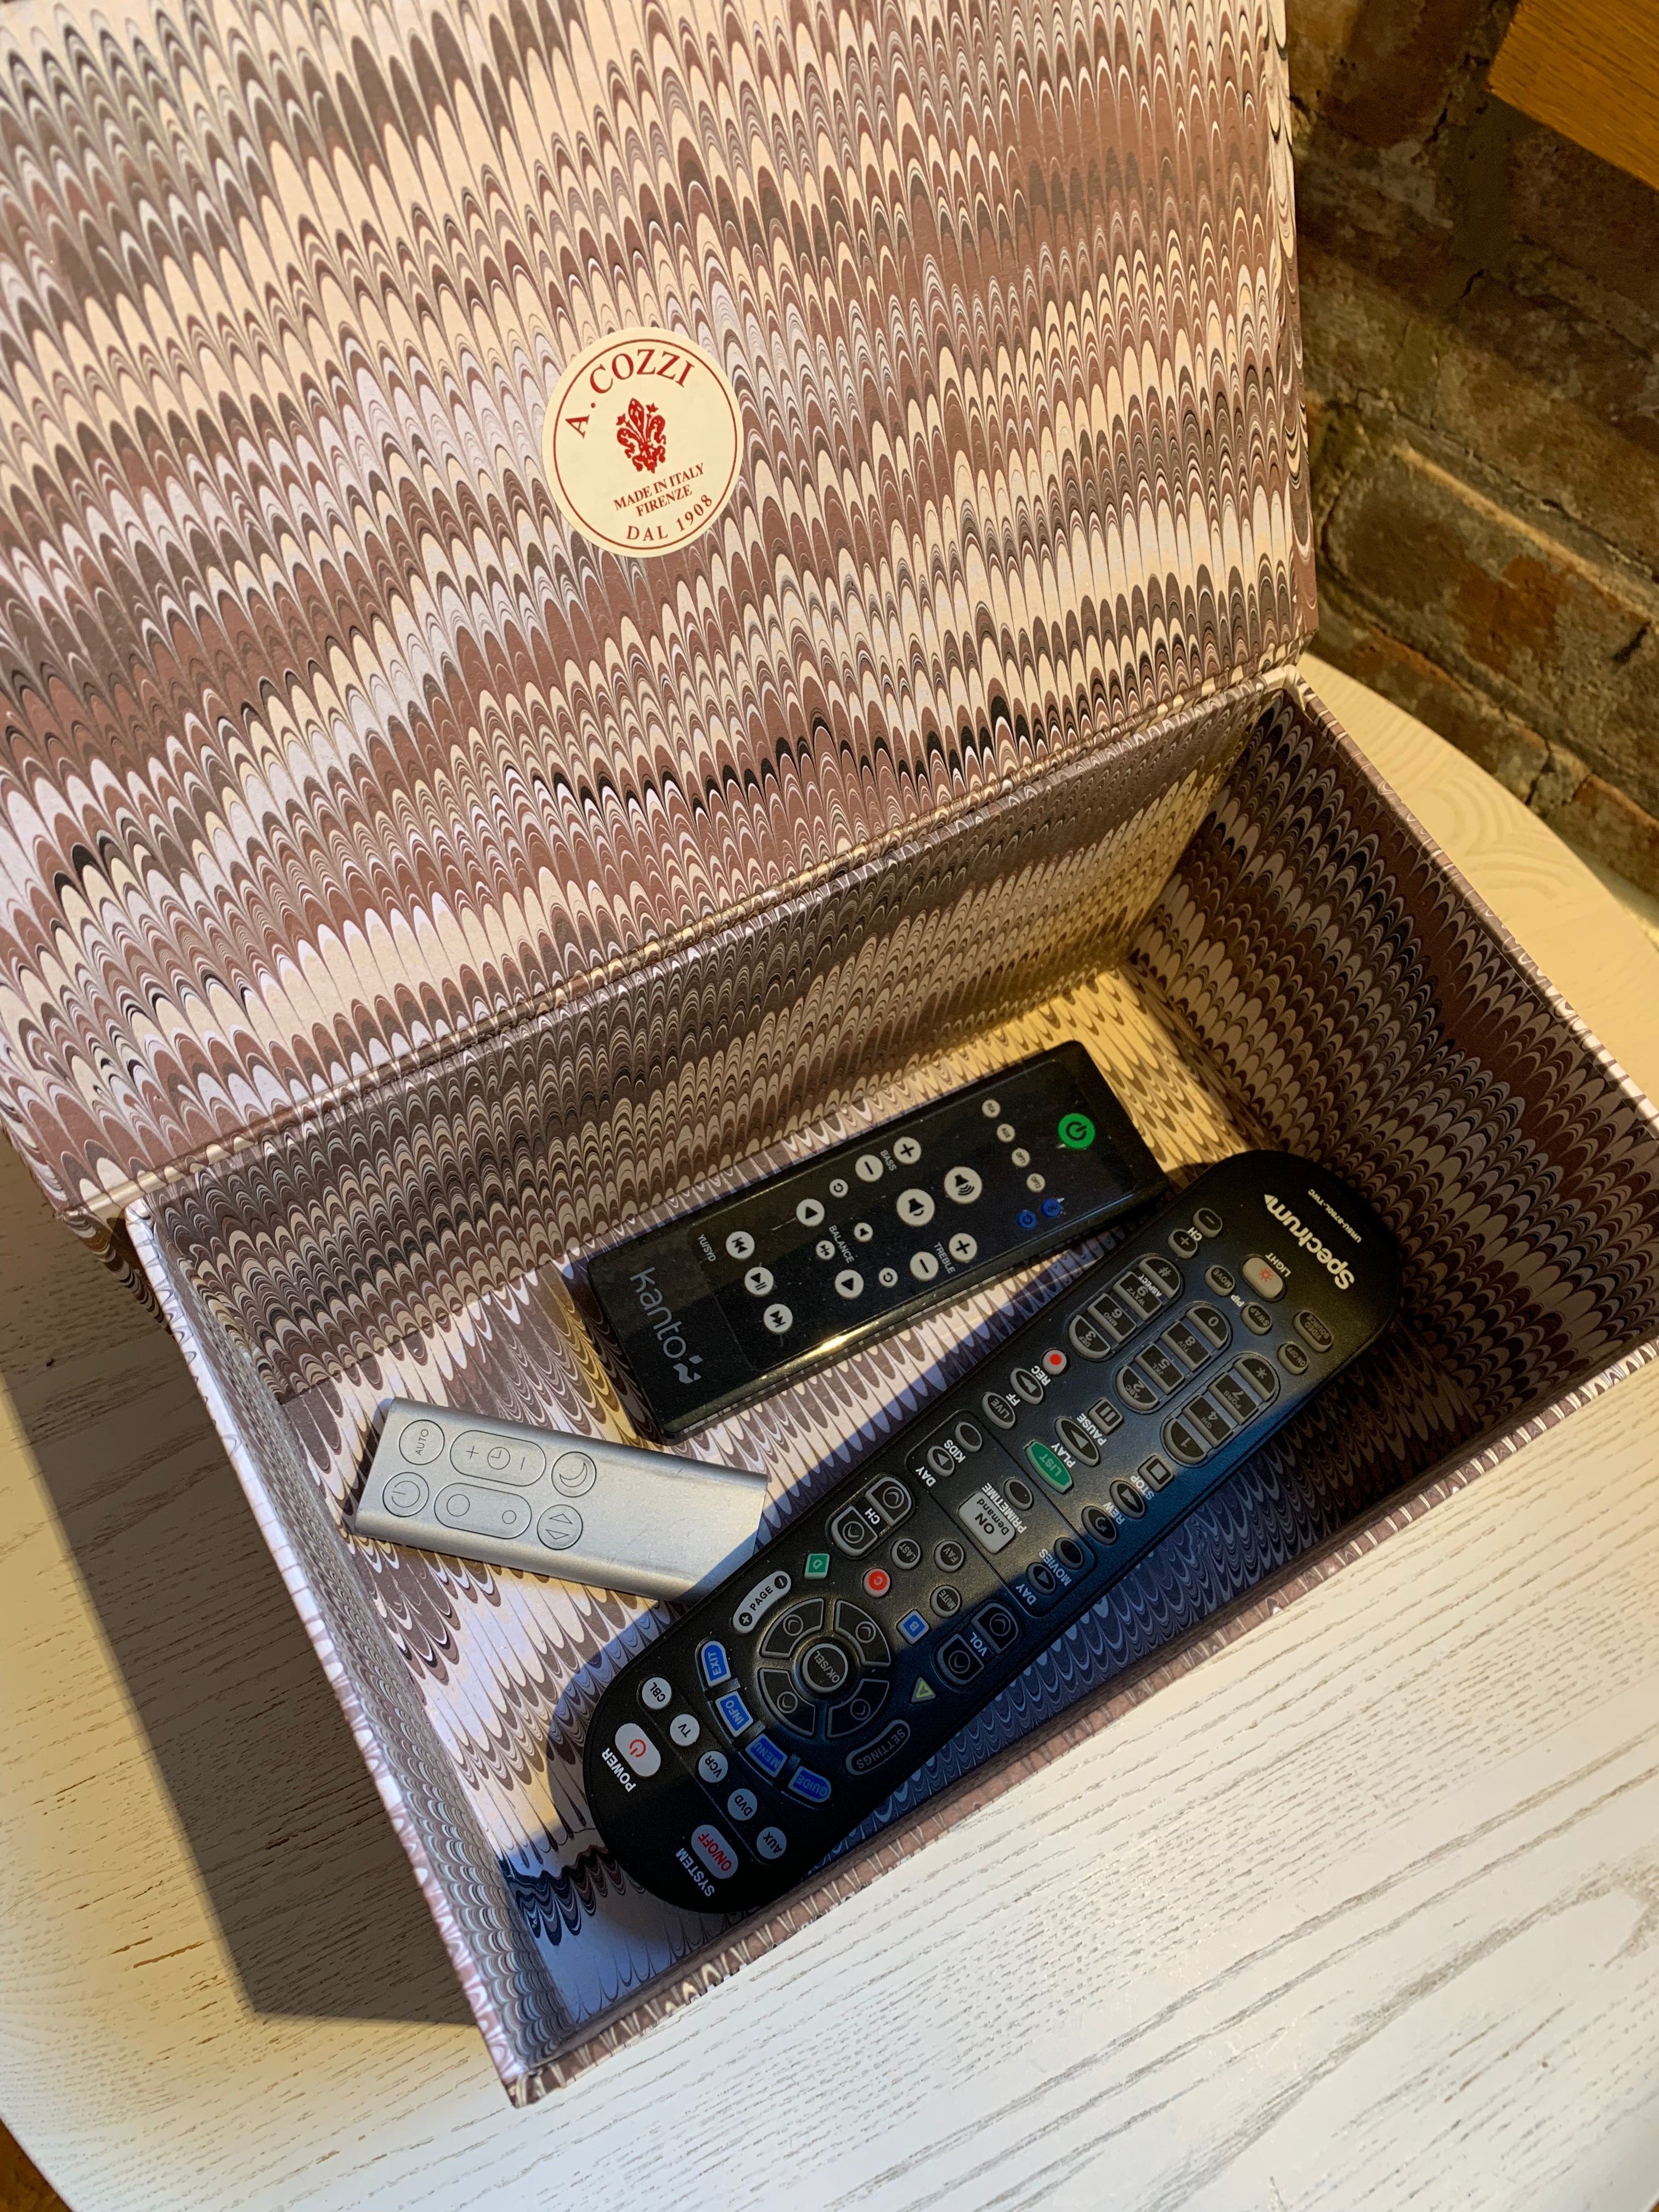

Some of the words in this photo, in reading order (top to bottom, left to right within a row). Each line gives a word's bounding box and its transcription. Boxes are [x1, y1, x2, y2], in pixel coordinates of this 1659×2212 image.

[589, 349, 695, 394] COZZI
[613, 486, 652, 510] MADE
[653, 479, 667, 494] IN
[669, 463, 703, 487] ITALY
[636, 484, 692, 516] FIRENZE
[627, 526, 668, 541] DAL
[677, 495, 712, 531] 1908
[1002, 1128, 1011, 1138] AUX
[880, 1150, 897, 1171] BASS
[829, 1225, 854, 1263] BALANCE
[1187, 1227, 1202, 1241] CH
[1266, 1196, 1355, 1289] Spectrum
[698, 1234, 716, 1261] YU/SYD
[934, 1242, 956, 1274] TREBLE
[1265, 1252, 1291, 1277] LIGHT
[1138, 1275, 1162, 1297] ASPECT
[1213, 1266, 1232, 1288] MOVE
[1126, 1287, 1145, 1307] WXYZ
[1137, 1286, 1148, 1296] 9
[1231, 1295, 1245, 1307] PIP
[630, 1267, 686, 1358] kanto
[1104, 1312, 1118, 1328] MNO
[1111, 1308, 1122, 1318] 6
[1208, 1317, 1219, 1327] 0
[1250, 1304, 1269, 1329] SWAP
[1085, 1330, 1096, 1341] 3
[1305, 1322, 1322, 1341] VIDEO
[1306, 1312, 1330, 1339] SOURCE
[1079, 1336, 1091, 1347] DEF
[1177, 1341, 1189, 1353] TUV
[1185, 1336, 1195, 1346] 8
[1153, 1363, 1164, 1376] JKL
[1158, 1356, 1171, 1369] 5
[1031, 1365, 1051, 1386] REC
[1133, 1380, 1145, 1392] 2
[1006, 1393, 1020, 1406] FF
[1124, 1385, 1140, 1401] ABC
[1223, 1390, 1242, 1409] PQRS
[1232, 1389, 1244, 1401] 7
[991, 1398, 1010, 1419] LIVE
[1207, 1411, 1218, 1420] 4
[1076, 1413, 1107, 1446] PAUSE
[415, 1429, 429, 1455] AUTO
[944, 1440, 966, 1463] KIDS
[1181, 1437, 1191, 1447] 1
[1039, 1454, 1062, 1477] LIST
[1051, 1443, 1076, 1468] PLAY
[916, 1466, 936, 1487] DAY
[1130, 1475, 1154, 1499] STOP
[865, 1508, 880, 1524] CH
[977, 1498, 1009, 1536] Demand
[982, 1482, 1027, 1533] PRIMETIME
[1102, 1502, 1125, 1524] REW
[975, 1513, 995, 1534] ON
[899, 1540, 916, 1561] LAST
[943, 1547, 958, 1563] FAV
[812, 1559, 823, 1570] D
[1036, 1546, 1071, 1586] MOVIES
[873, 1576, 883, 1585] C
[749, 1586, 773, 1611] PAGE
[939, 1590, 956, 1610] MUTE
[1015, 1584, 1036, 1605] DAY
[910, 1621, 919, 1632] B
[970, 1632, 987, 1656] VOL
[708, 1652, 722, 1675] EXIT
[811, 1648, 840, 1683] OK/SEL
[650, 1682, 665, 1702] CBL
[726, 1700, 744, 1725] INFO
[678, 1724, 691, 1738] TV
[754, 1740, 781, 1769] MENU
[856, 1728, 906, 1769] SETTINGS
[602, 1747, 636, 1792] POWER
[705, 1755, 722, 1778] VCR
[794, 1773, 827, 1797] GUIDE
[735, 1795, 753, 1816] DVD
[698, 1833, 732, 1871] ON/OFF
[763, 1832, 782, 1854] AUX
[676, 1848, 714, 1897] SYSTEM
